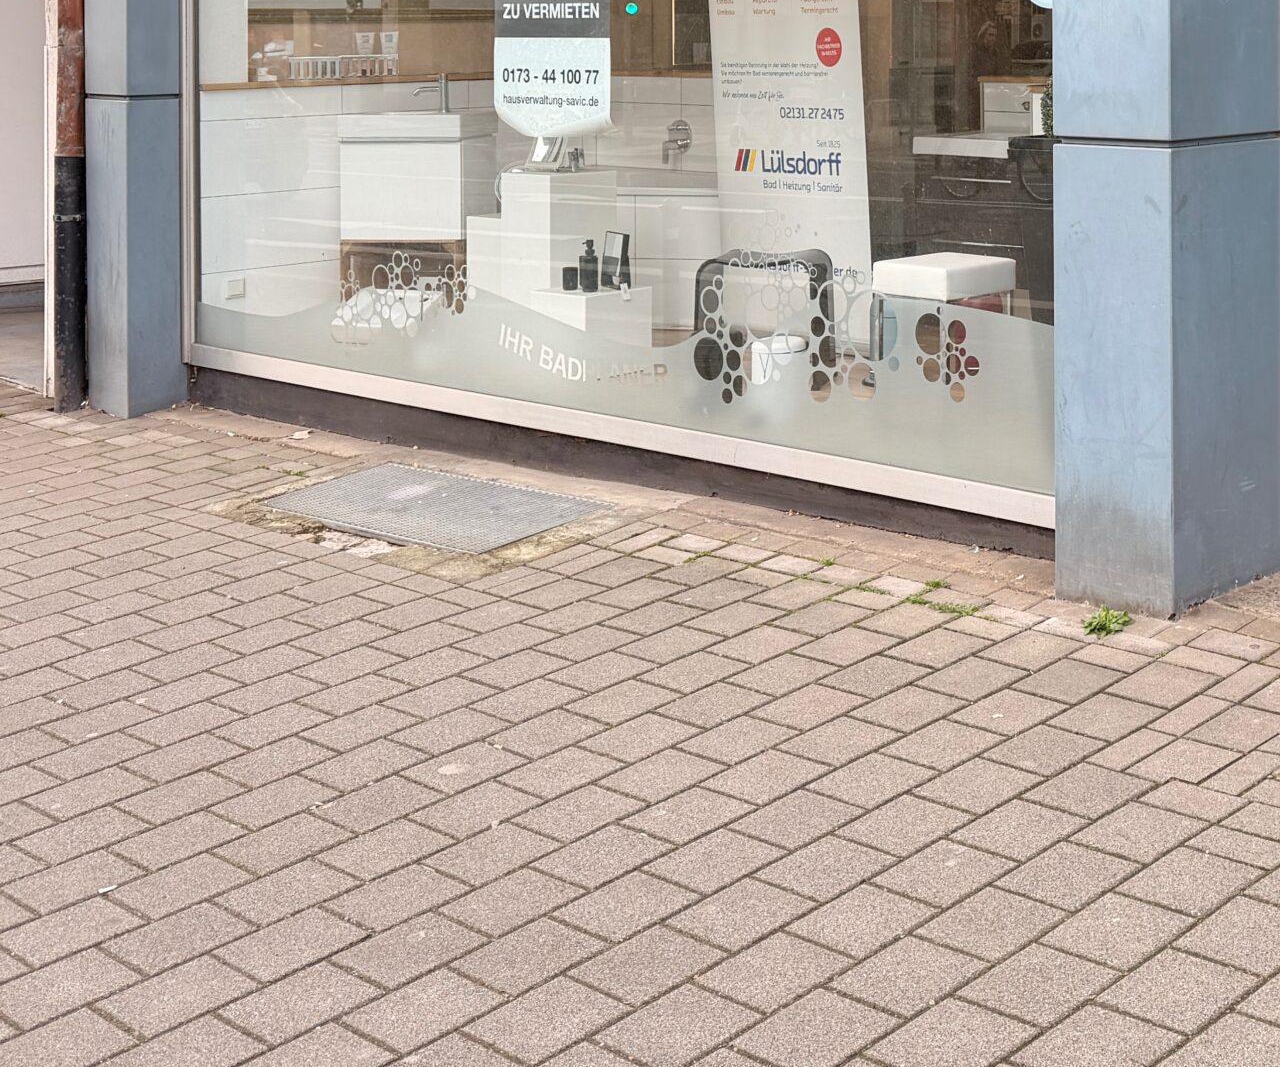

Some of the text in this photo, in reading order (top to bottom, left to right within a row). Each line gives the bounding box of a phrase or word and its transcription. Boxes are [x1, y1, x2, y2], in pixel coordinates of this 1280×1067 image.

[502, 2, 600, 19] ZU VERMIETEN
[502, 68, 530, 83] 0173
[542, 69, 556, 83] 44
[560, 69, 581, 84] 100
[585, 69, 599, 84] 77
[503, 94, 599, 108] hausverwaltung-savic.de
[761, 149, 842, 176] Lülsdorff
[763, 180, 777, 189] Bad
[782, 181, 811, 193] Heizung
[817, 183, 843, 193] Sanitär
[499, 323, 534, 362] IHR
